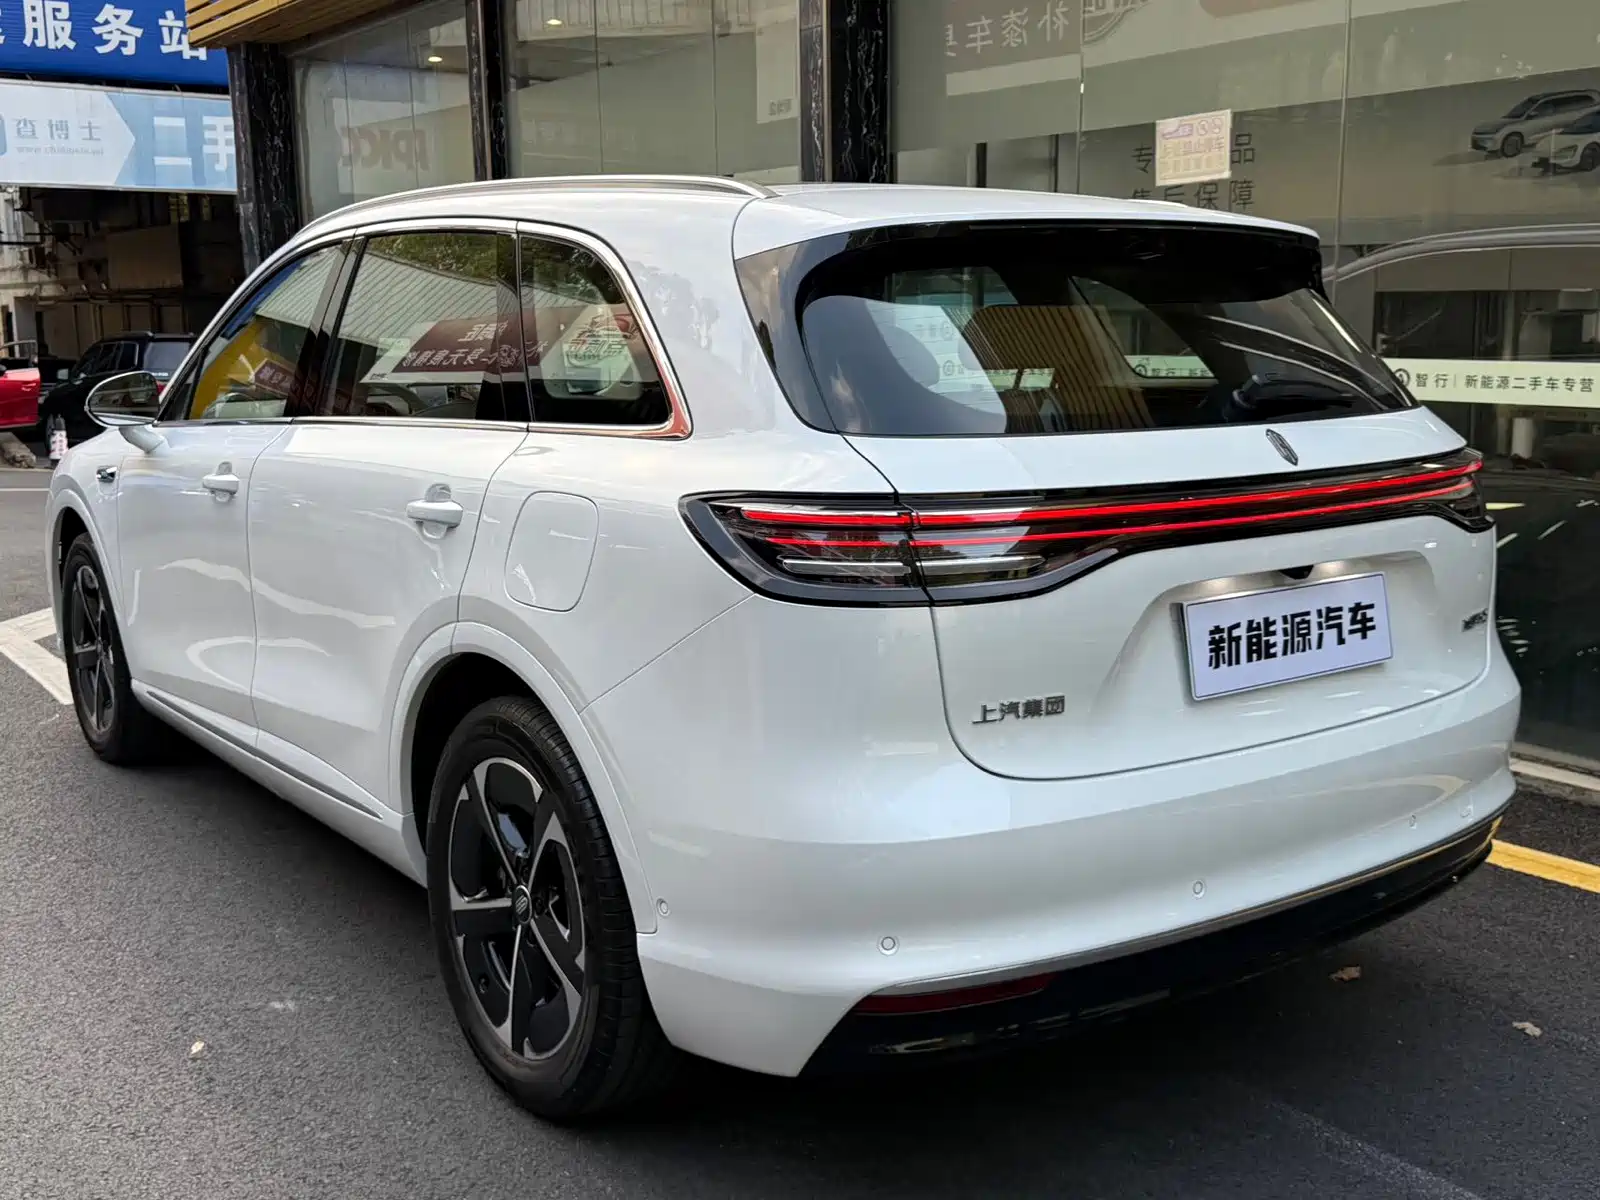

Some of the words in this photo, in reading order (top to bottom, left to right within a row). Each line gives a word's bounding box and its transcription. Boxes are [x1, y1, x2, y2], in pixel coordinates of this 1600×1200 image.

[0, 0, 208, 60] 服务站
[14, 118, 102, 141] 查博士
[1415, 373, 1449, 388] 智行
[1464, 374, 1594, 393] 新能源二手车专营
[1208, 602, 1377, 669] 新能源汽车
[971, 695, 1065, 724] 上汽集团
